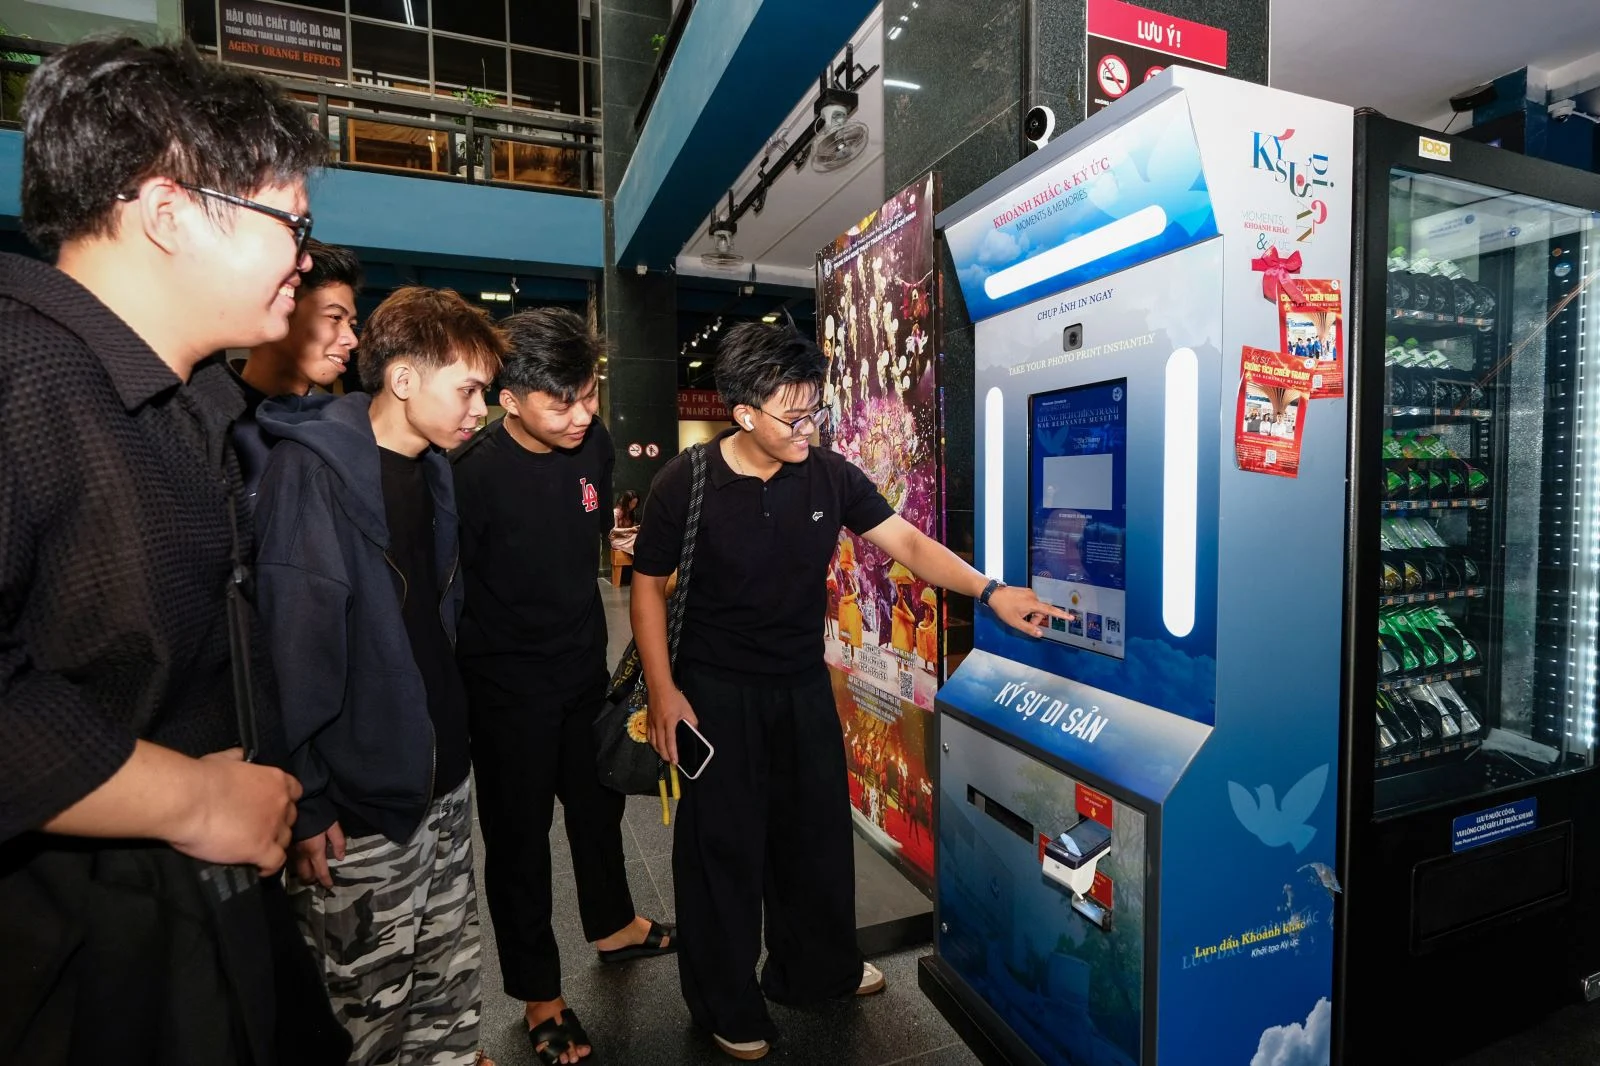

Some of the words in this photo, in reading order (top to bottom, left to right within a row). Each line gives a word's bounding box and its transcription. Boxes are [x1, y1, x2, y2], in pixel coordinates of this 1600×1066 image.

[225, 8, 243, 24] HẬU
[246, 12, 263, 26] QUẢ
[266, 13, 287, 31] CHẤT
[290, 19, 307, 34] ĐỘC
[323, 26, 340, 40] CAM
[1137, 20, 1162, 43] LƯU
[1166, 24, 1182, 48] Ý!
[228, 40, 259, 55] AGENT
[262, 46, 300, 60] ORANGE
[303, 52, 341, 67] EFFECTS
[1421, 138, 1449, 157] TORO
[1063, 179, 1072, 192] &
[1072, 166, 1089, 187] KÝ
[1016, 208, 1047, 232] MOMENTS
[1047, 205, 1053, 217] &
[1053, 188, 1088, 215] MEMORIES
[1037, 307, 1058, 321] CHỤP
[1059, 302, 1076, 315] ẢNH
[1078, 298, 1087, 308] IN
[1090, 288, 1113, 305] NGAY
[1009, 362, 1026, 377] TAKE
[1026, 359, 1046, 373] YOUR
[1048, 352, 1074, 367] PHOTO
[1076, 345, 1101, 361] PRINT
[1103, 333, 1155, 356] INSTANTLY
[692, 394, 709, 403] FNL
[712, 394, 725, 403] FO
[580, 477, 598, 512] LA
[994, 681, 1028, 707] KÝ
[1015, 690, 1050, 721] SỰ
[1040, 700, 1070, 727] DI
[1061, 705, 1109, 743] SẢN
[1194, 945, 1217, 959] Lưu
[1219, 935, 1239, 952] dấu
